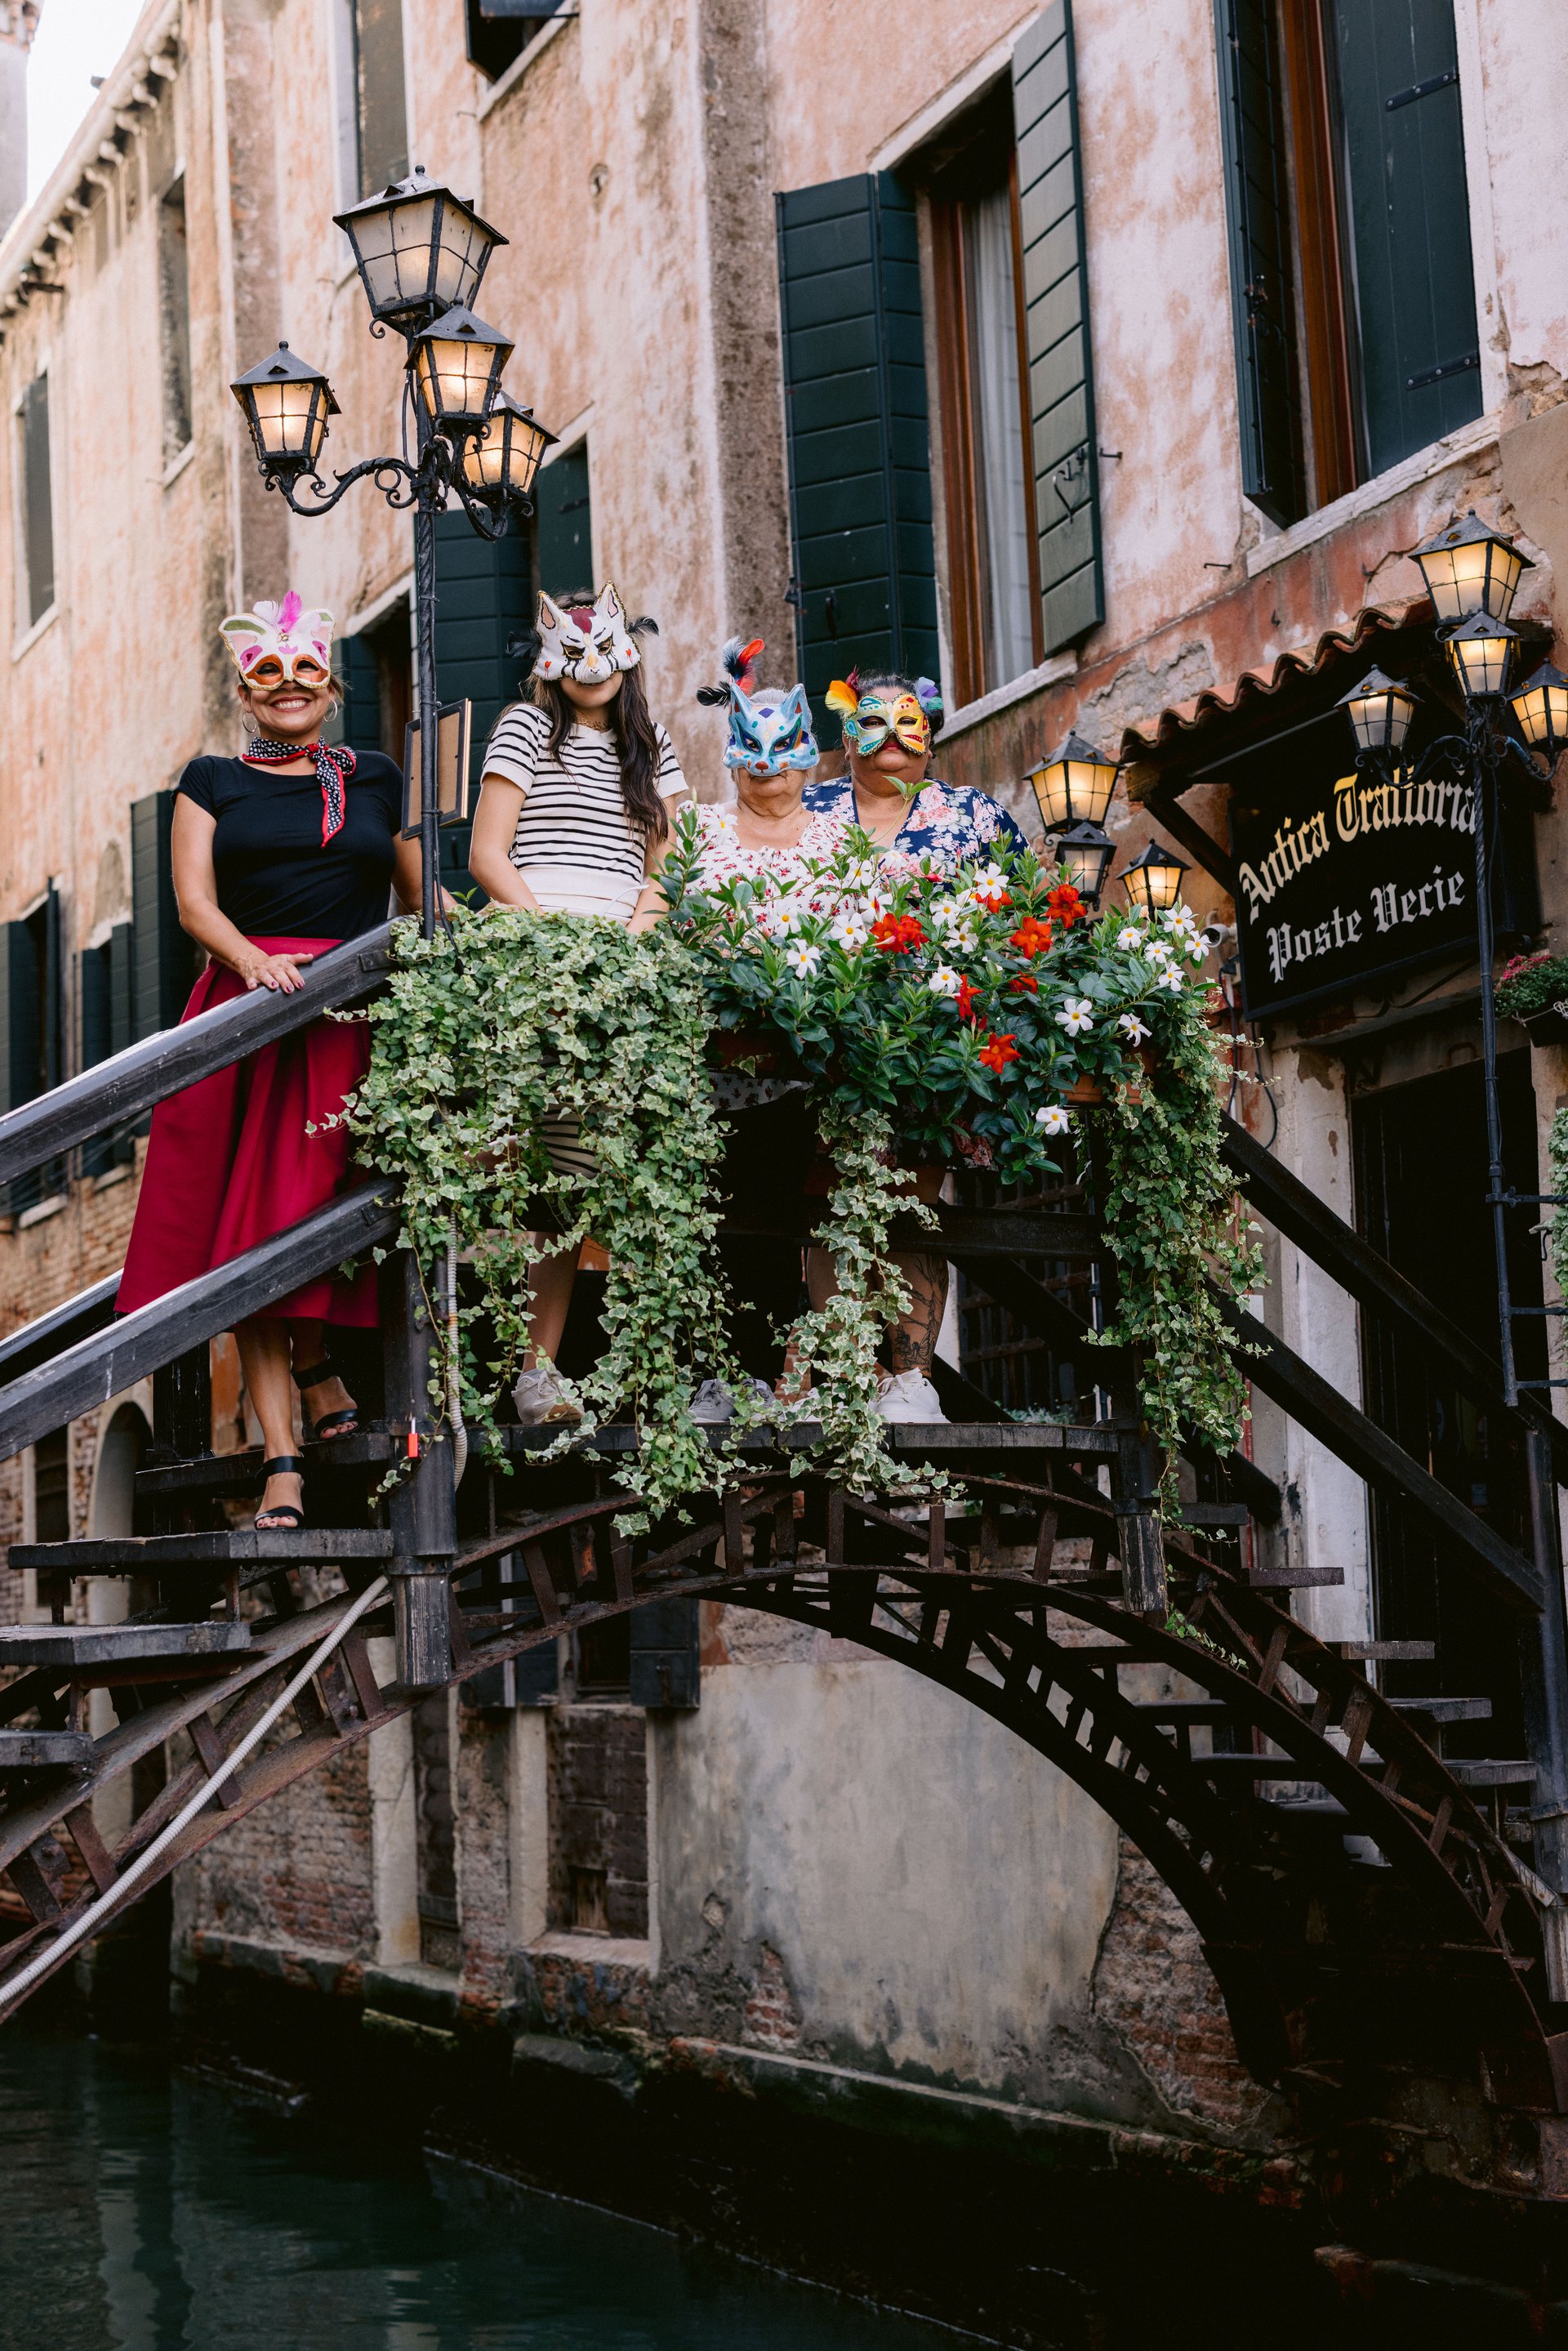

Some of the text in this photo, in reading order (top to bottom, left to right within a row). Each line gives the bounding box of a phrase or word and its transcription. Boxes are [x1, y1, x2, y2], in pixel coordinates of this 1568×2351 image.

[1240, 765, 1476, 925] Antica Trattoria
[1267, 865, 1465, 983] Poste Vecie
